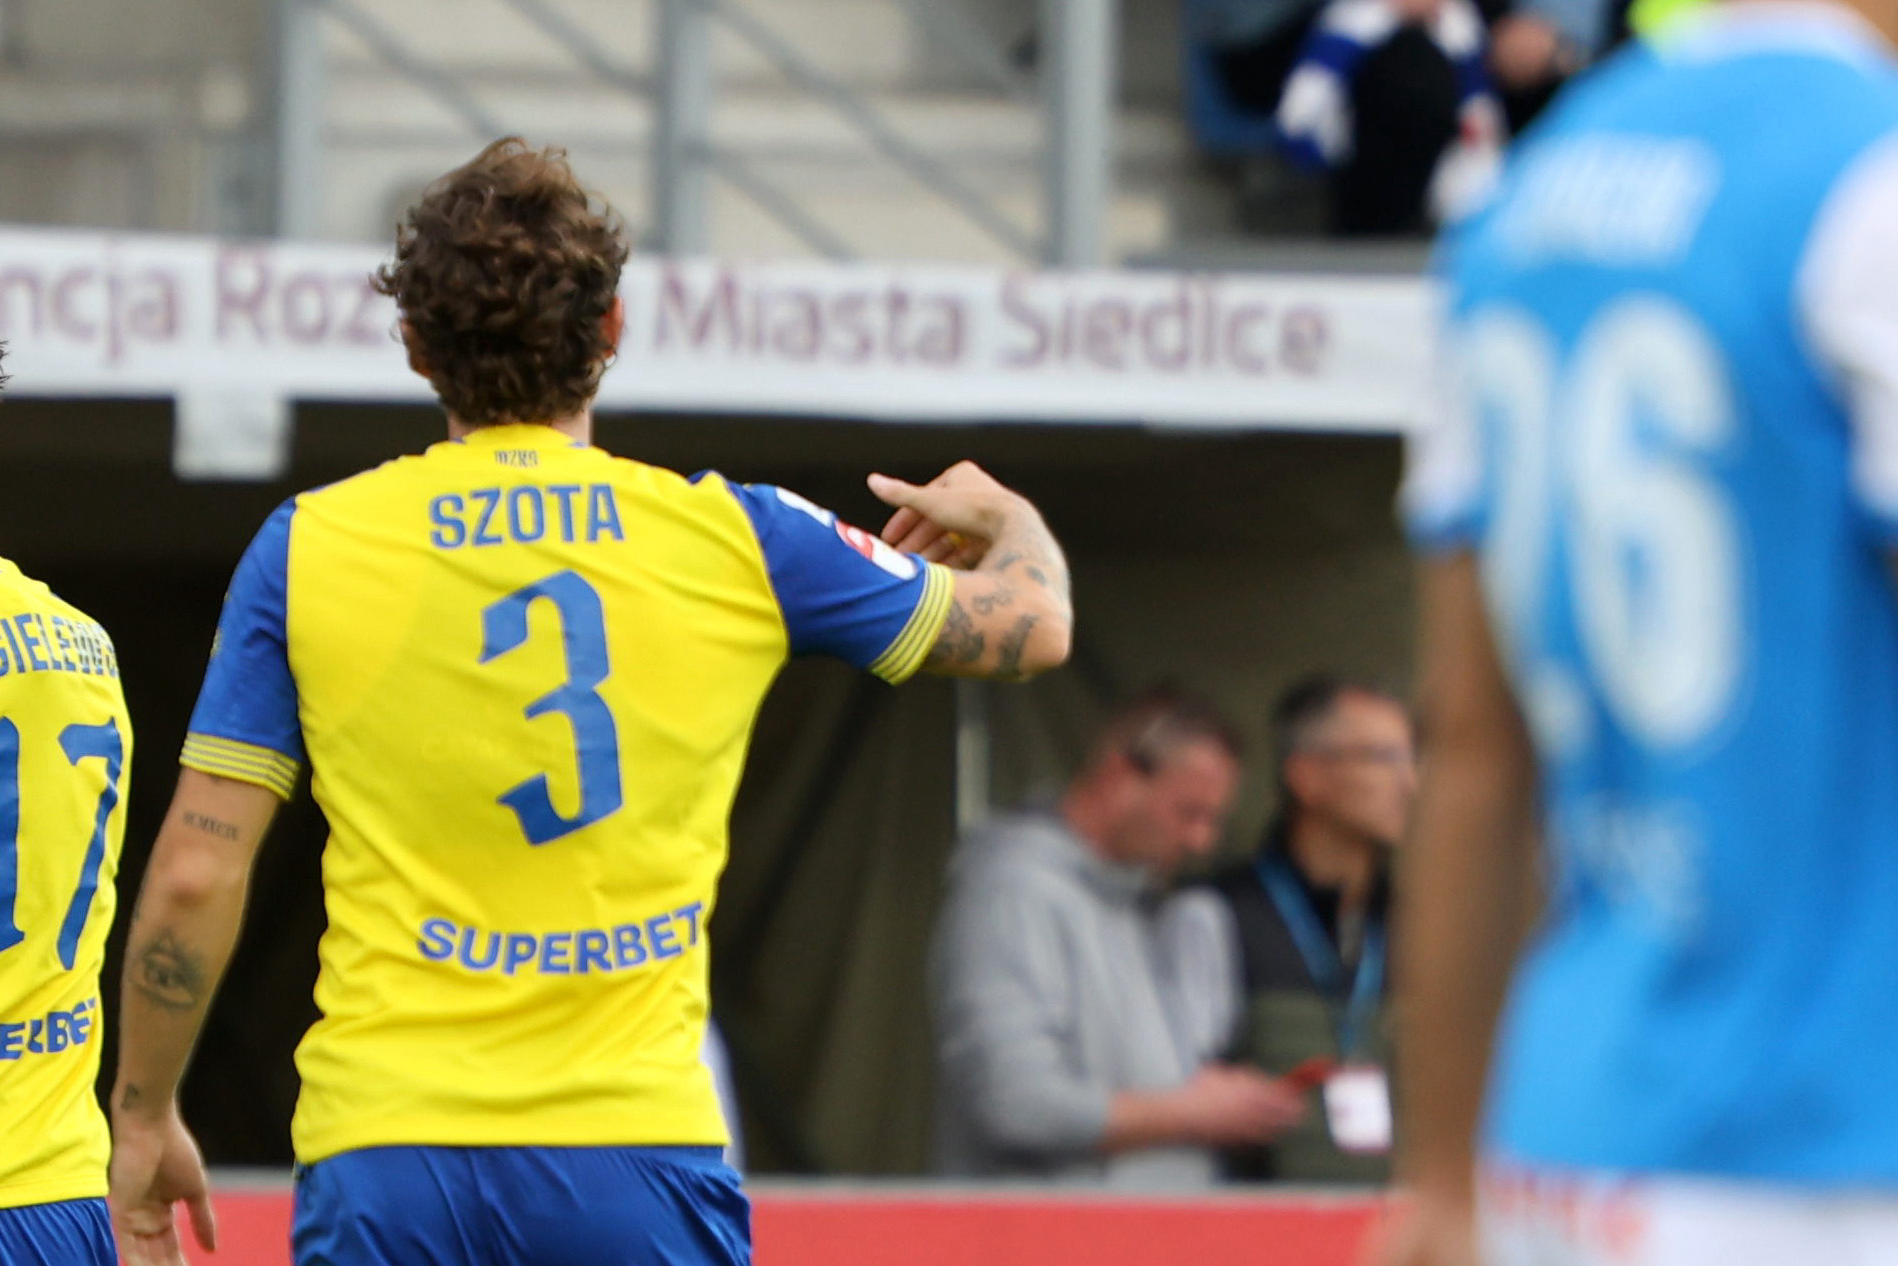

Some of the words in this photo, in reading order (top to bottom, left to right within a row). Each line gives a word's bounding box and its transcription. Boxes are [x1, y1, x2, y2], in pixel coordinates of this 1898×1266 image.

[652, 258, 966, 364] Miasta
[995, 268, 1332, 376] Siedlce
[430, 484, 624, 549] SZOTA
[478, 569, 622, 847] 3
[418, 902, 704, 976] SUPERBET
